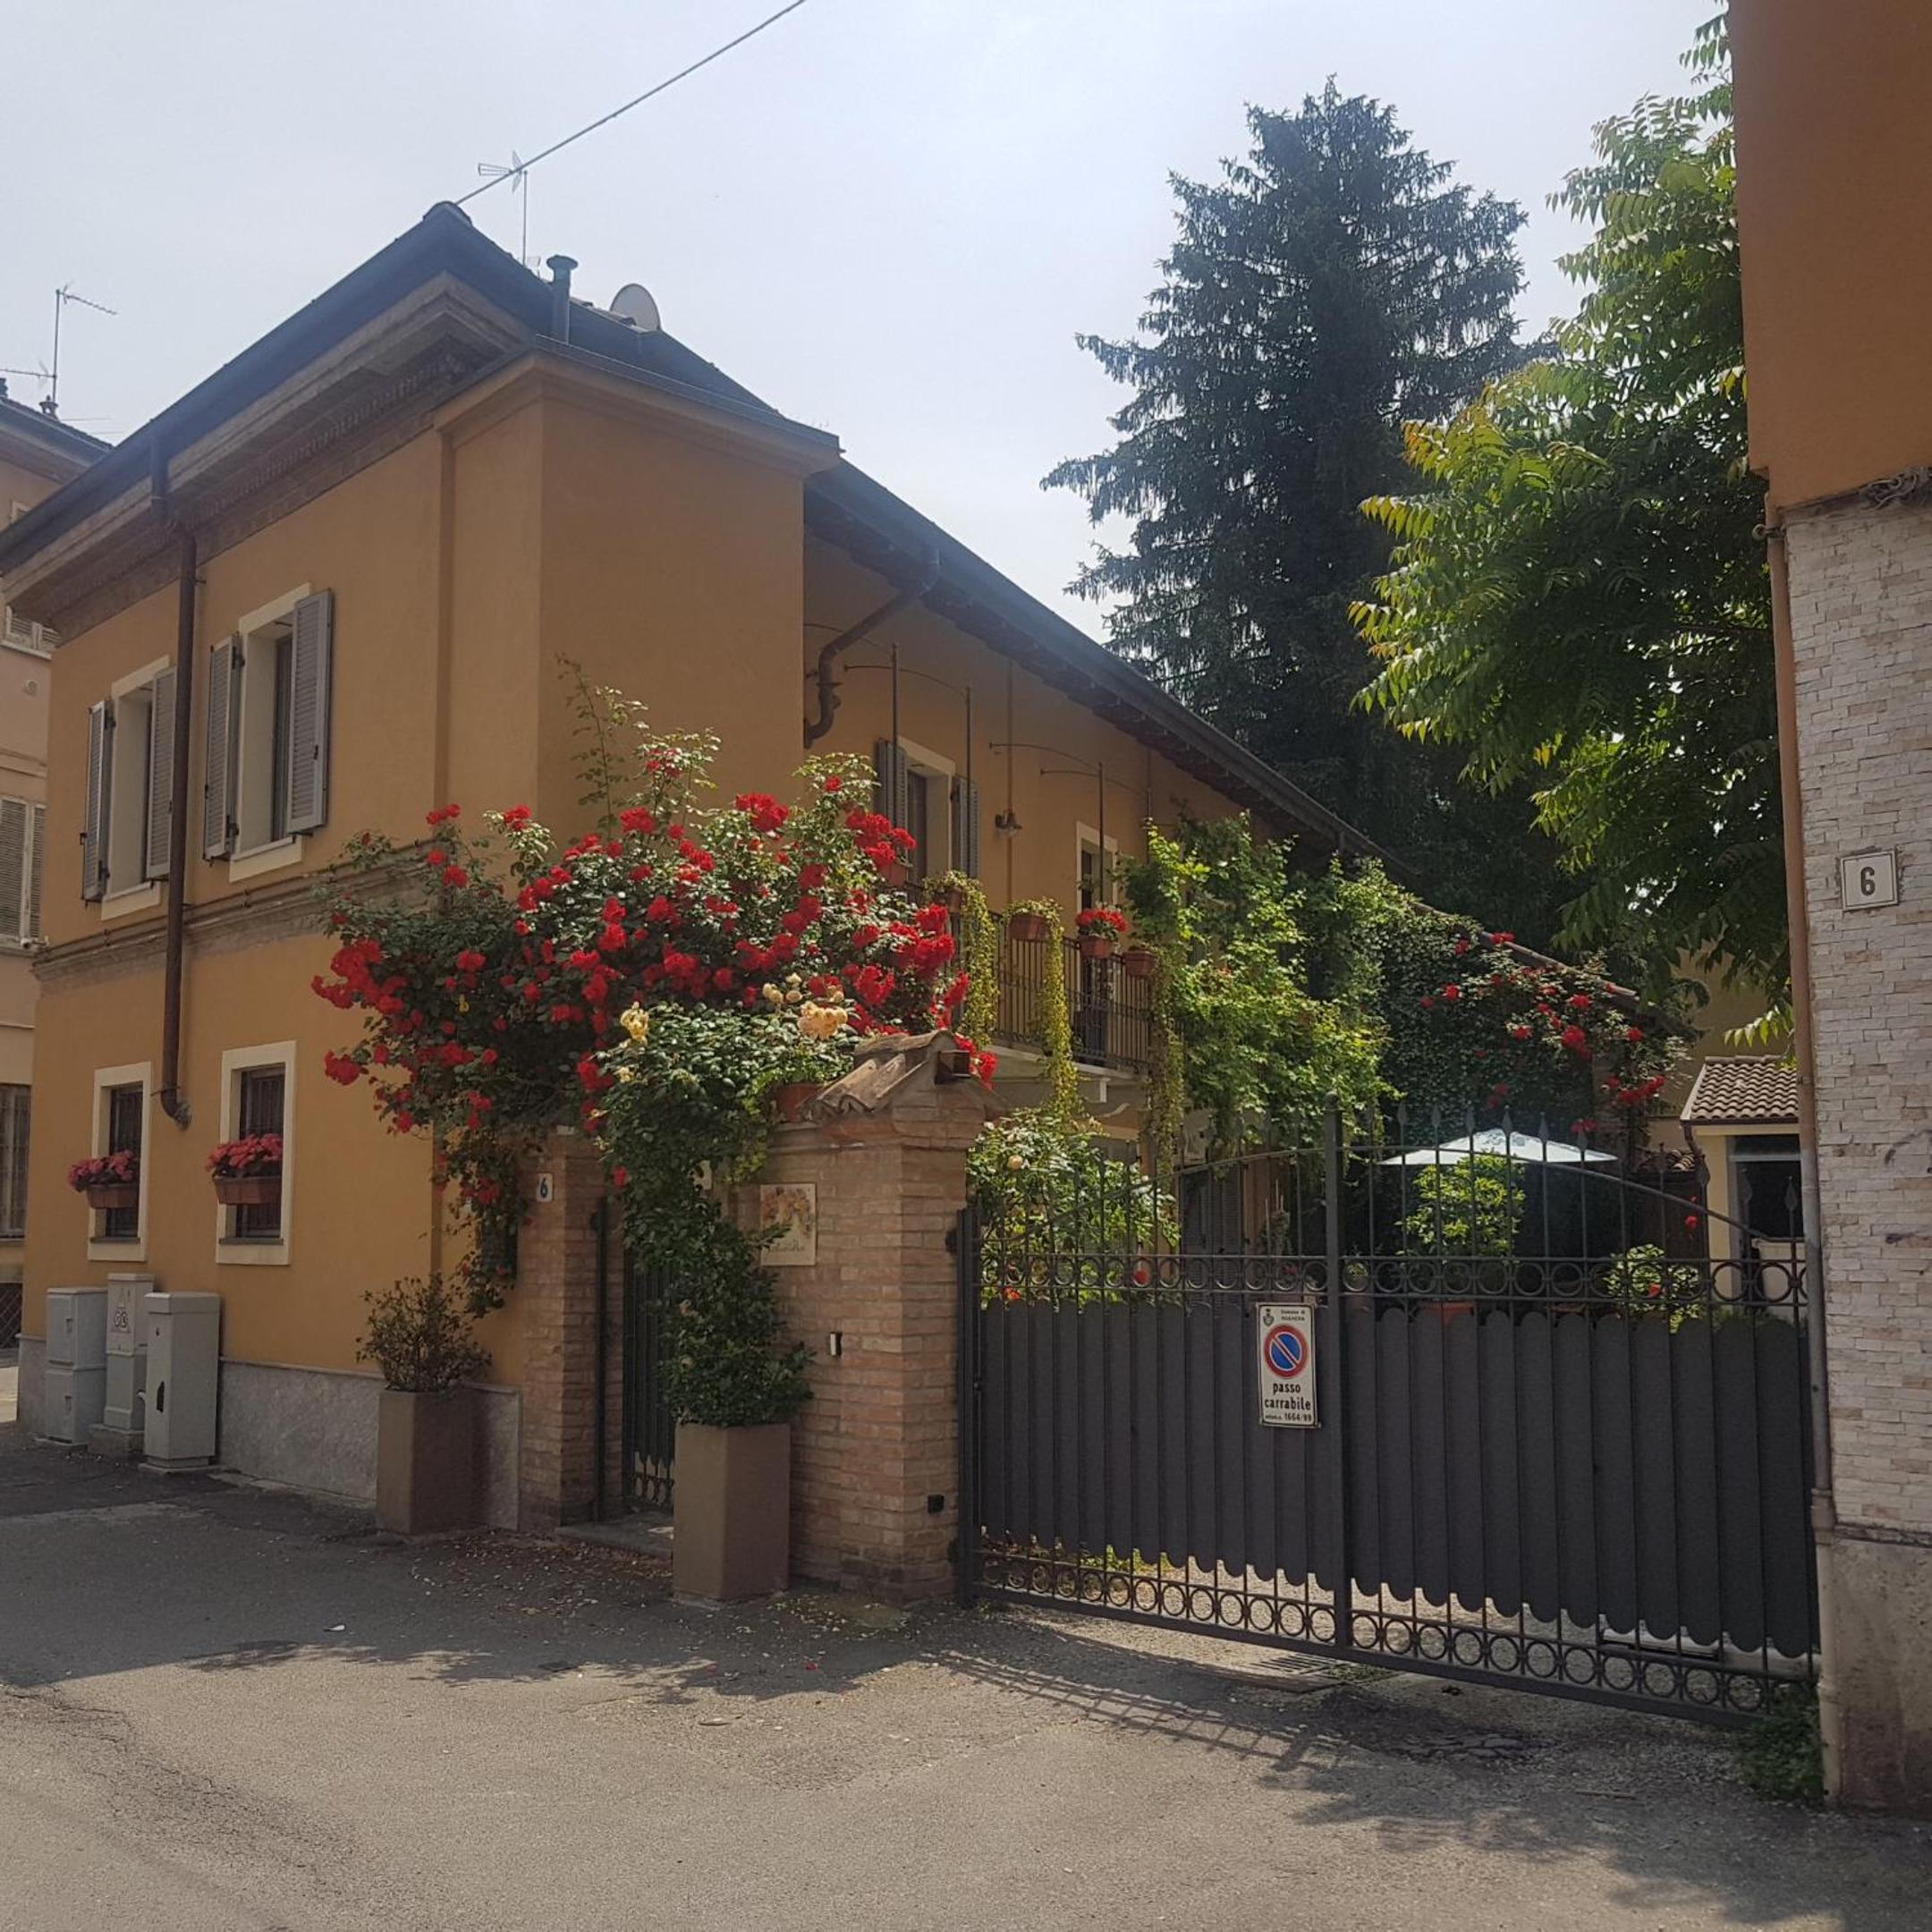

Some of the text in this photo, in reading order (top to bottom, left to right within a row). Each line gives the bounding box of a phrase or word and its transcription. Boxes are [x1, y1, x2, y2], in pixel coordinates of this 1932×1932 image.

[1860, 866, 1877, 896] 6
[540, 1177, 548, 1199] 6
[1273, 1382, 1301, 1395] passo
[1264, 1395, 1311, 1411] carrabile
